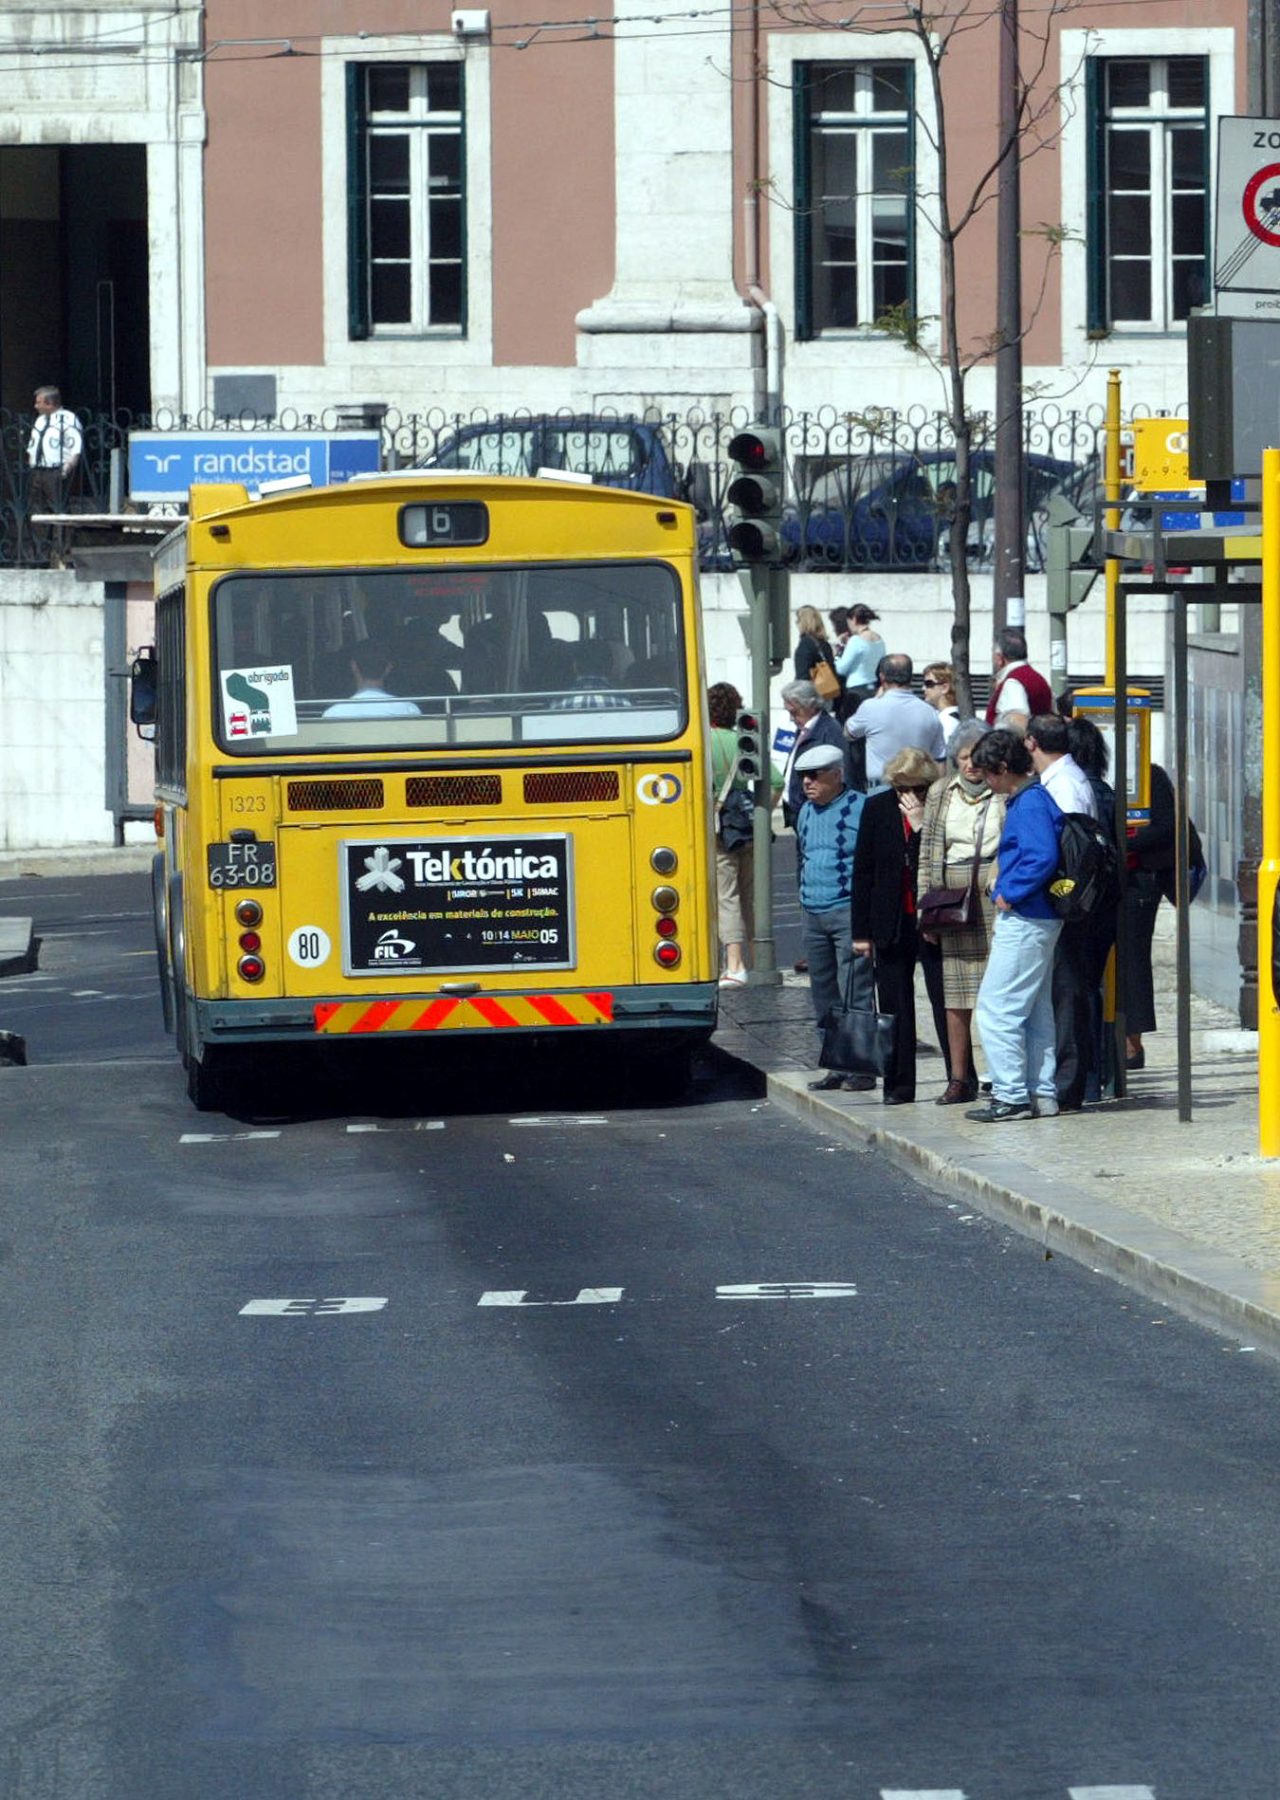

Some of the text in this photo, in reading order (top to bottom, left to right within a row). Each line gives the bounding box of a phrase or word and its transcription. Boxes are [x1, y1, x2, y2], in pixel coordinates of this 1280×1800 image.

[193, 446, 311, 474] randstad
[1141, 467, 1148, 477] 6
[229, 796, 266, 813] 1323
[228, 843, 258, 864] FR
[406, 847, 558, 882] Tektónica
[210, 863, 274, 886] 63-08
[368, 913, 376, 921] A
[428, 912, 443, 920] em
[445, 908, 490, 919] materiais
[491, 908, 503, 918] de
[298, 932, 320, 960] 80
[539, 929, 558, 944] 05
[374, 946, 399, 959] FIL
